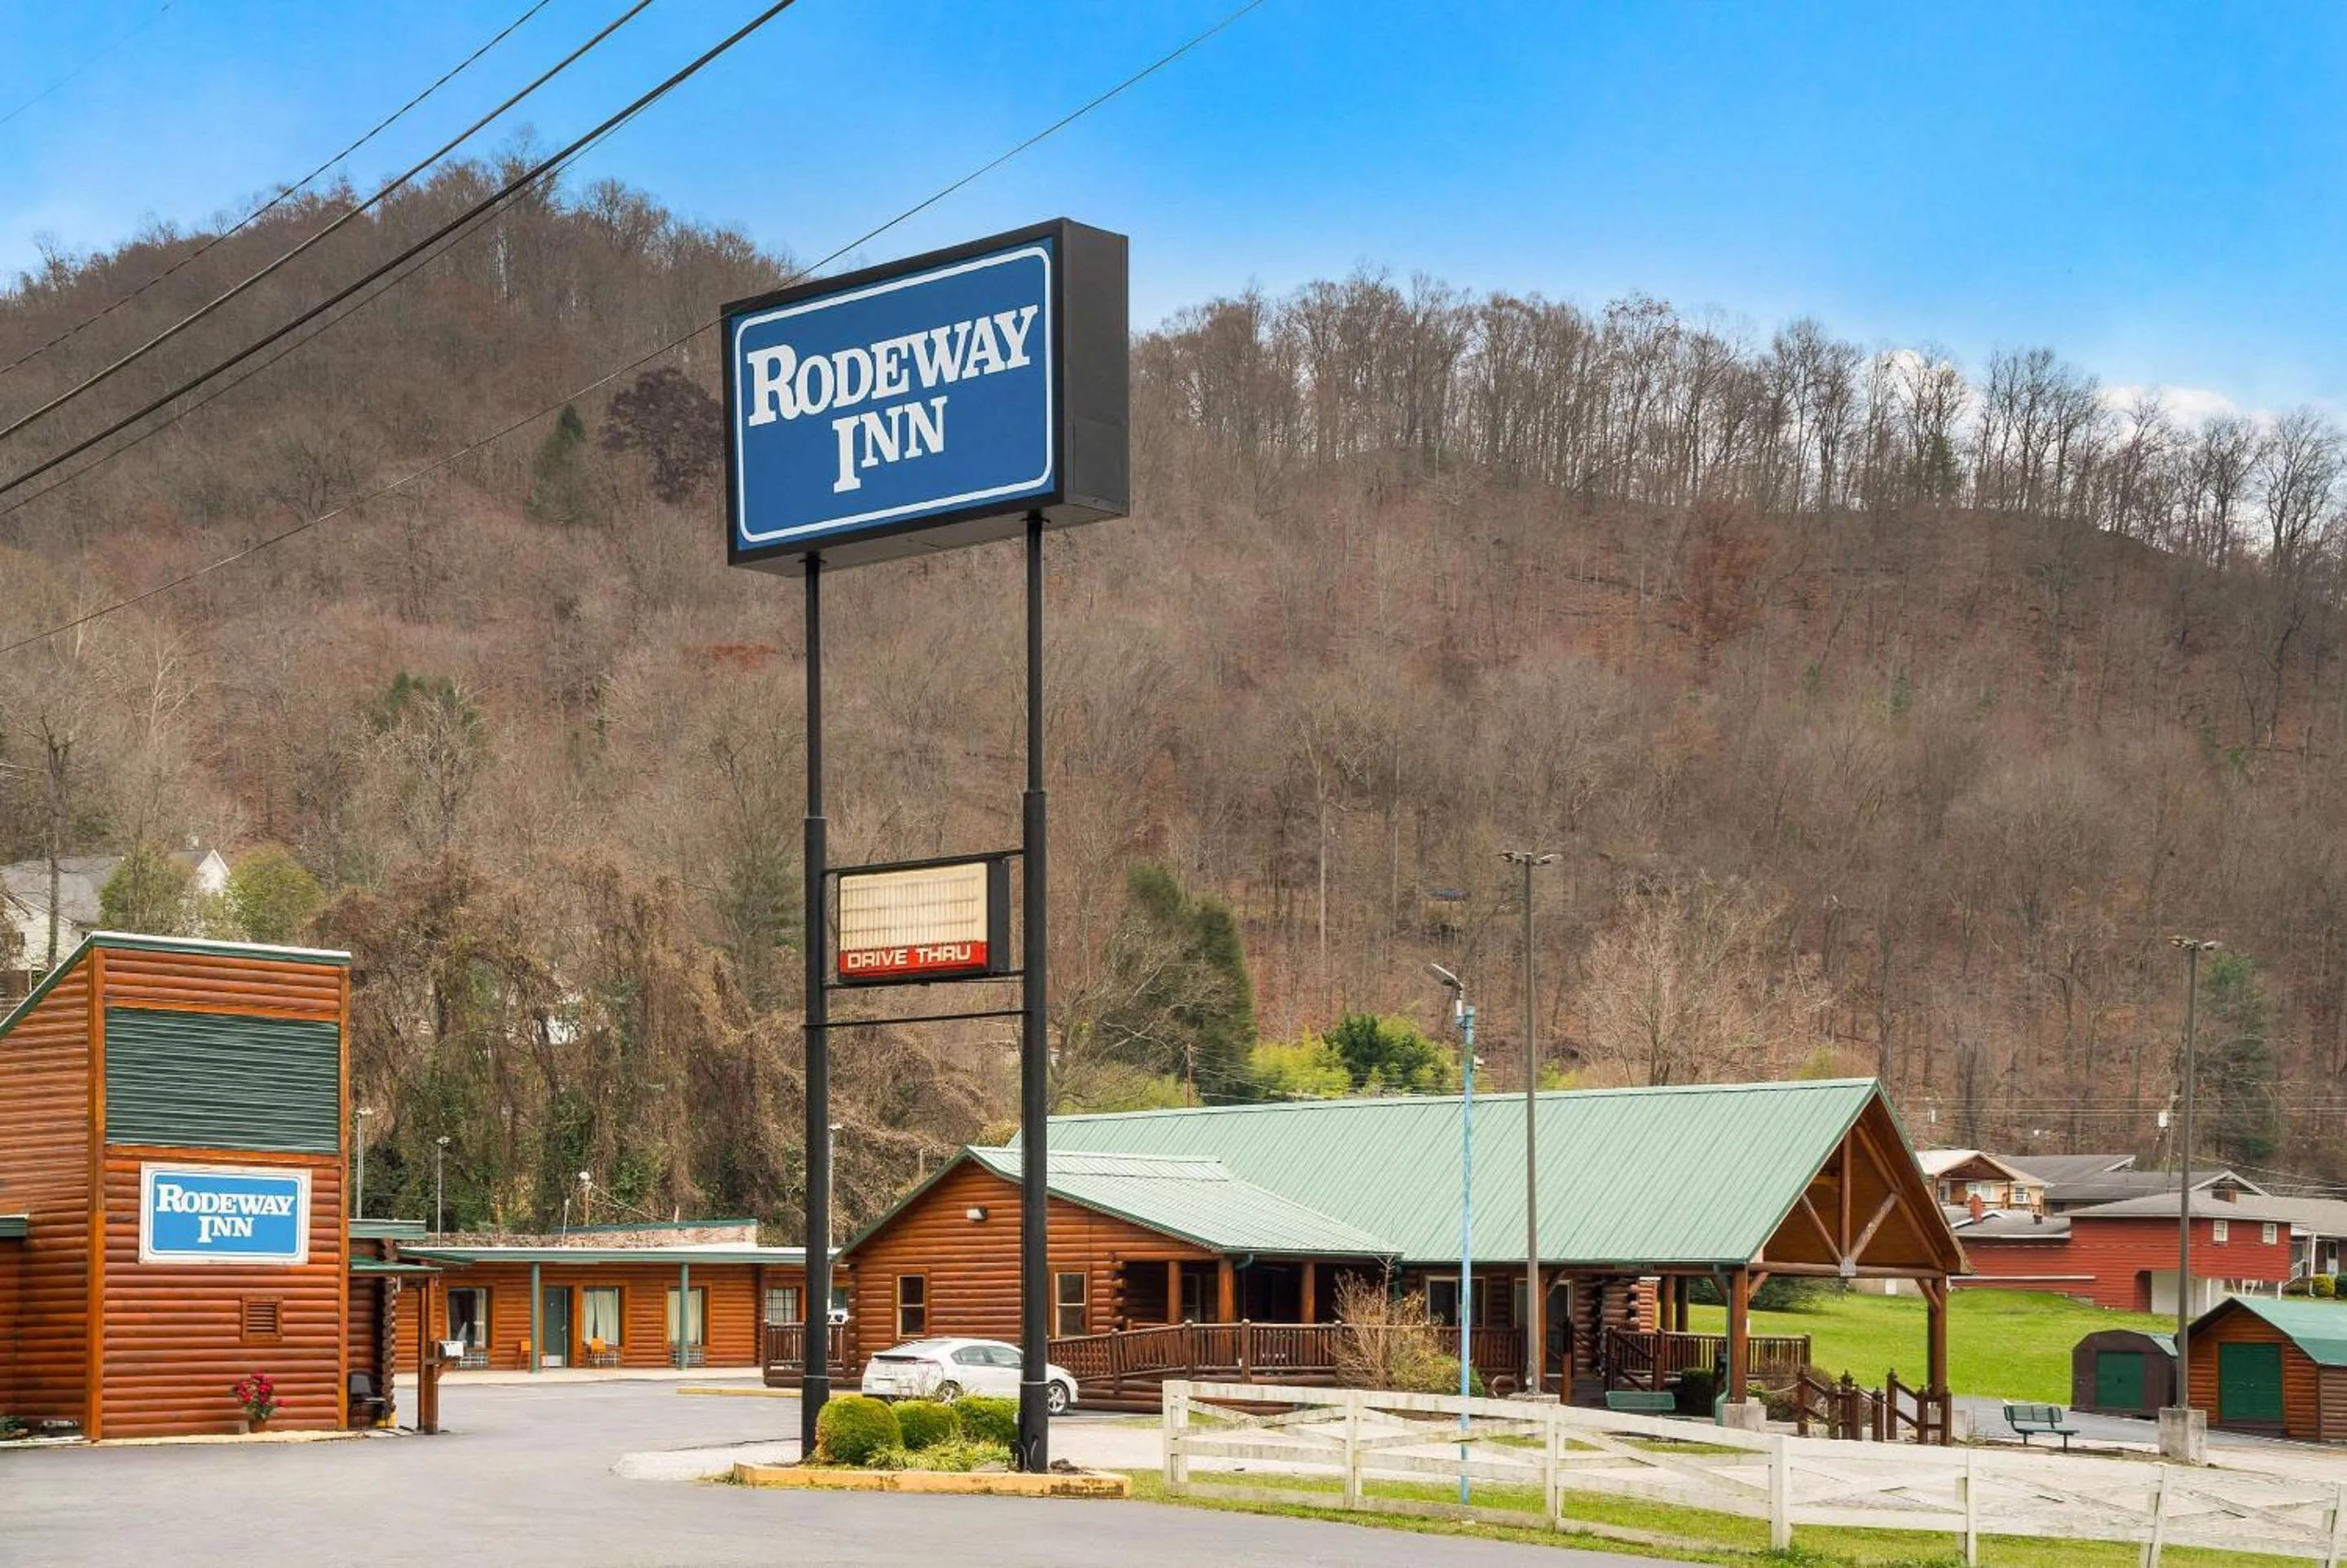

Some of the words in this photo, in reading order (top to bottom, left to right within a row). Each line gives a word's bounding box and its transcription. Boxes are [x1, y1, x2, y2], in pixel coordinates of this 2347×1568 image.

[747, 305, 1038, 426] RODEWAY
[832, 396, 948, 493] INN
[848, 949, 907, 968] DRIVE
[916, 945, 971, 963] THRU
[156, 1184, 294, 1216] RODEWAY
[197, 1215, 254, 1243] INN
